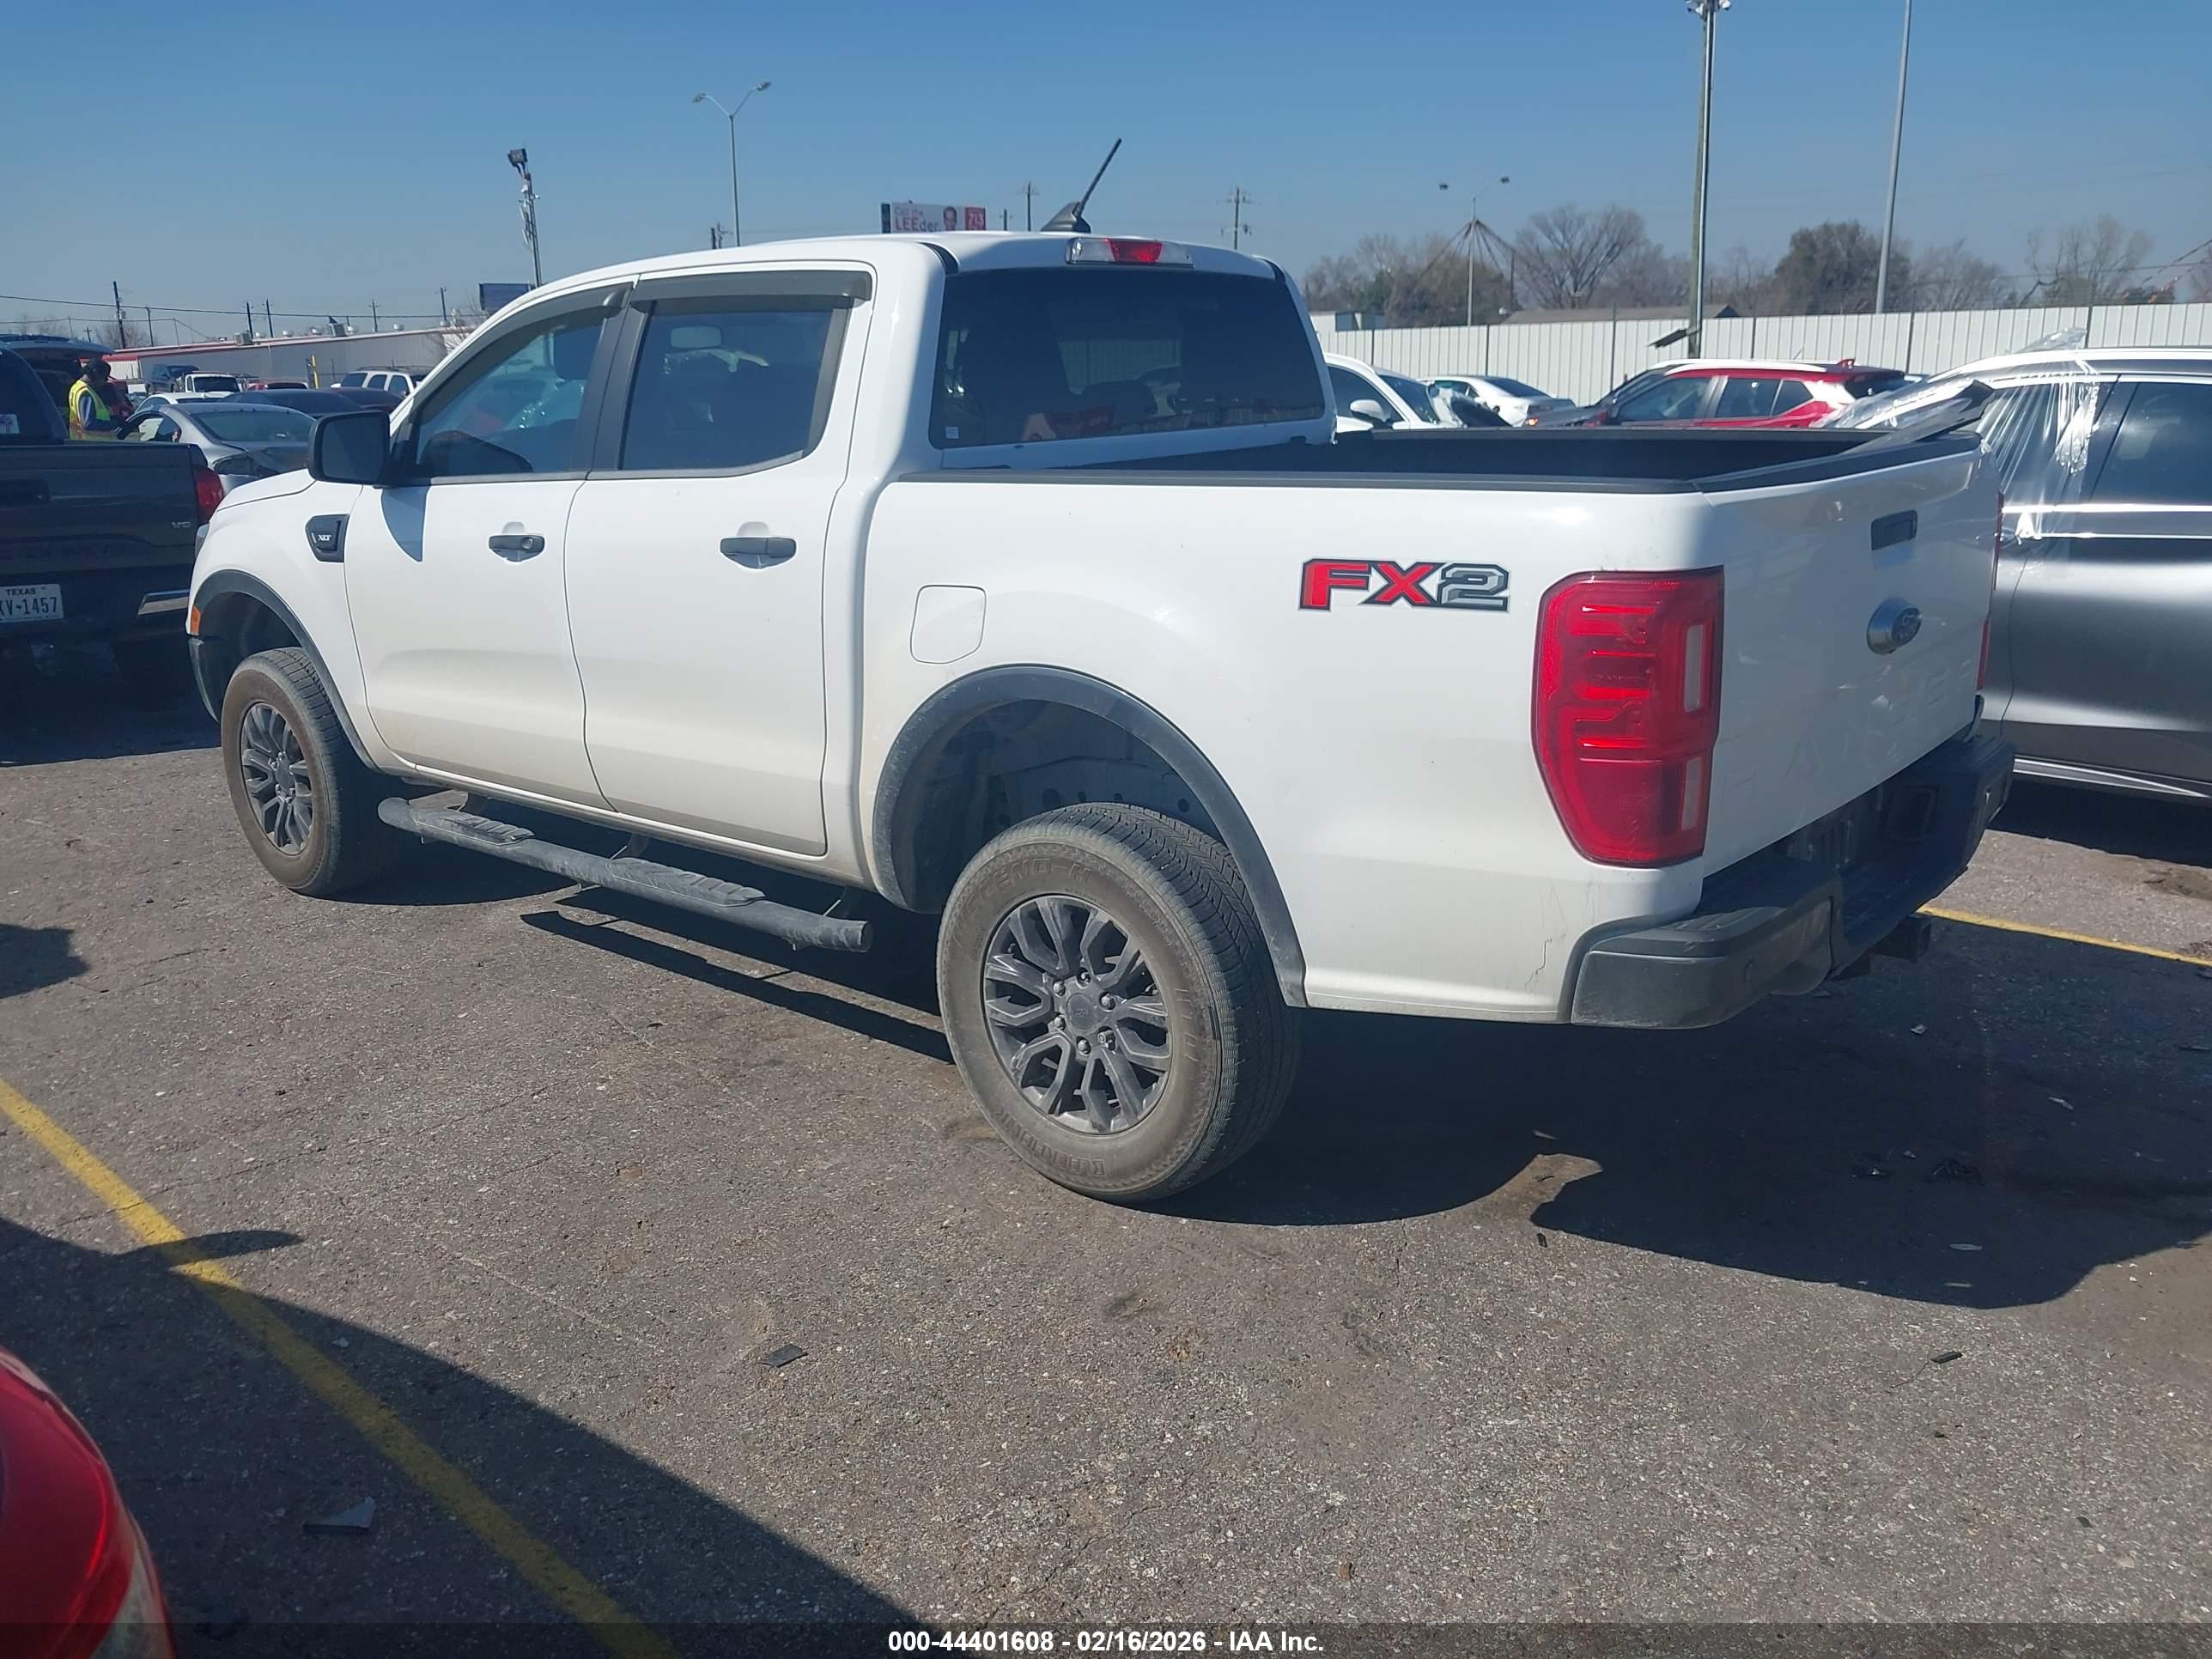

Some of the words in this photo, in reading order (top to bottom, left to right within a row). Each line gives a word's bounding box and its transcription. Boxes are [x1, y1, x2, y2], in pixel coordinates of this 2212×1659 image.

[5, 587, 36, 596] TEXAS
[1298, 557, 1510, 612] FX2
[989, 1105, 1107, 1177] BLACKHAWK
